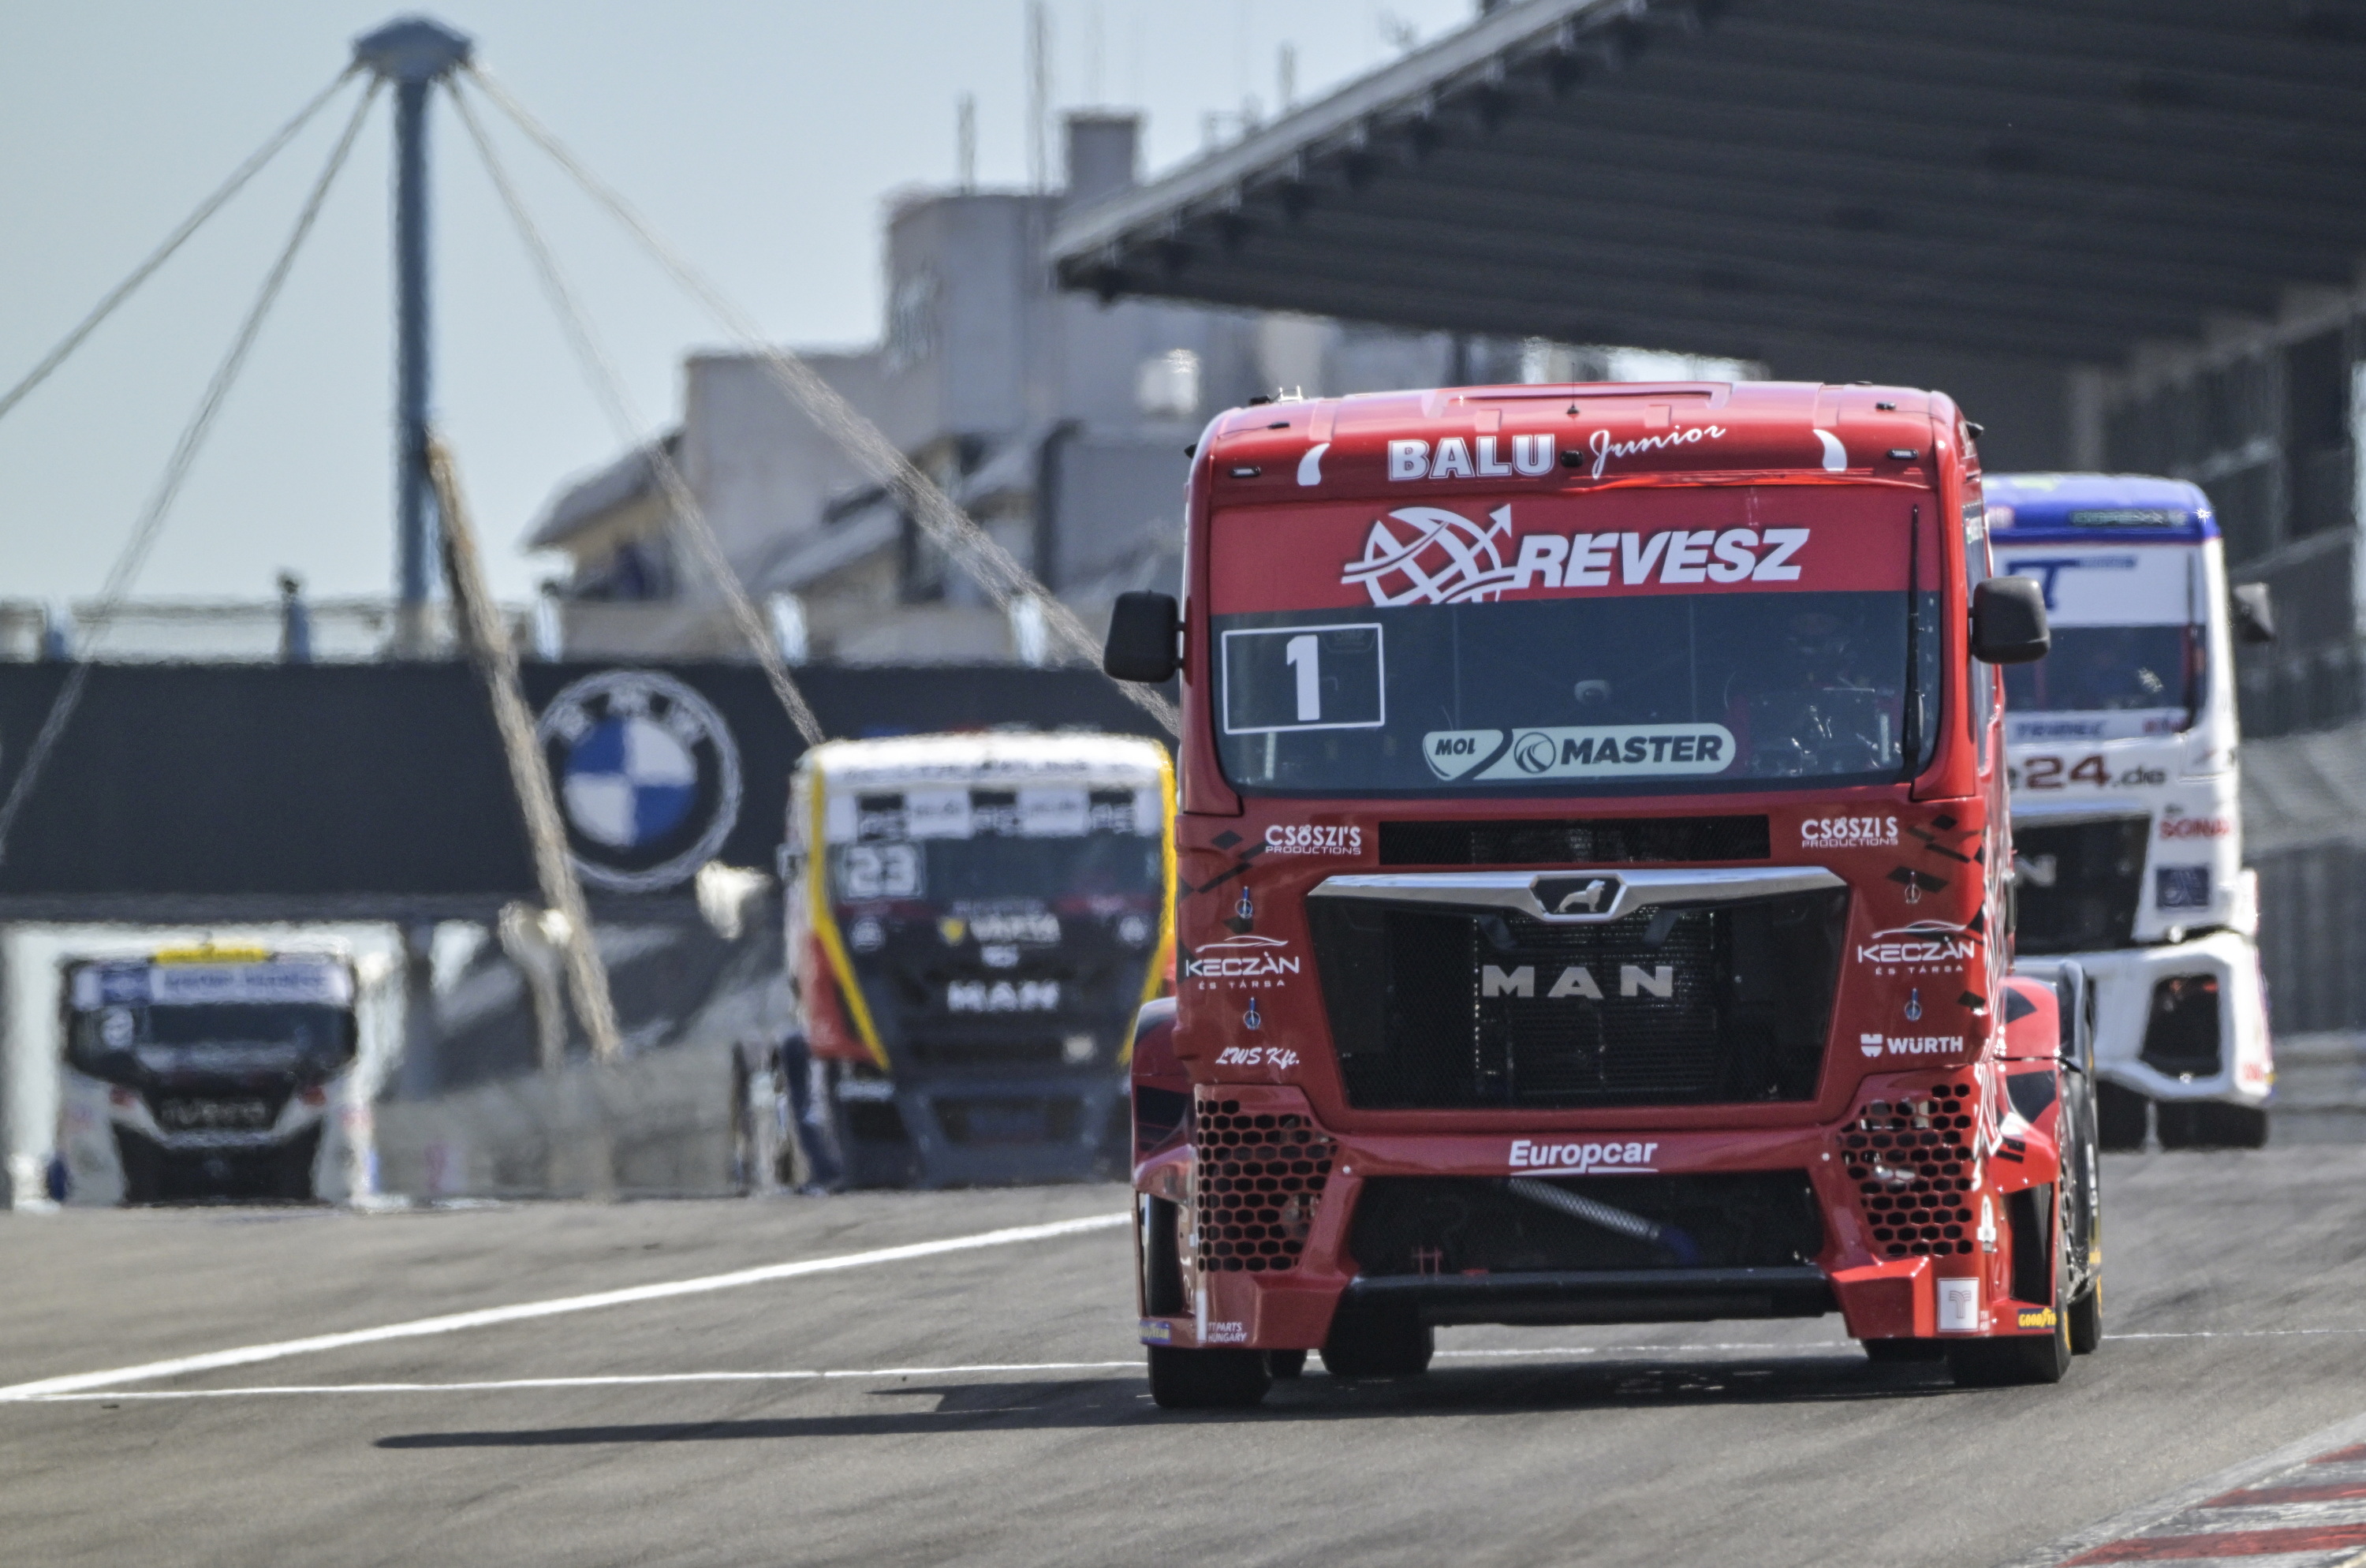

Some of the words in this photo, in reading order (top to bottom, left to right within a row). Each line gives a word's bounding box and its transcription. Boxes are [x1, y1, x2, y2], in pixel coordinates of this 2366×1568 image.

[1387, 434, 1554, 481] BALU
[1588, 421, 1726, 480] Junior
[1513, 527, 1811, 588] REVESZ
[1286, 634, 1320, 722] 1
[1435, 737, 1476, 756] MOL
[1560, 734, 1723, 765] MASTER
[1265, 846, 1361, 855] PRODUCTIONS
[1801, 837, 1898, 848] PRODUCTIONS
[947, 979, 1060, 1013] MAN
[1482, 965, 1673, 999] MAN
[1886, 1036, 1963, 1055] WÜRTH
[1508, 1141, 1658, 1174] Europcar
